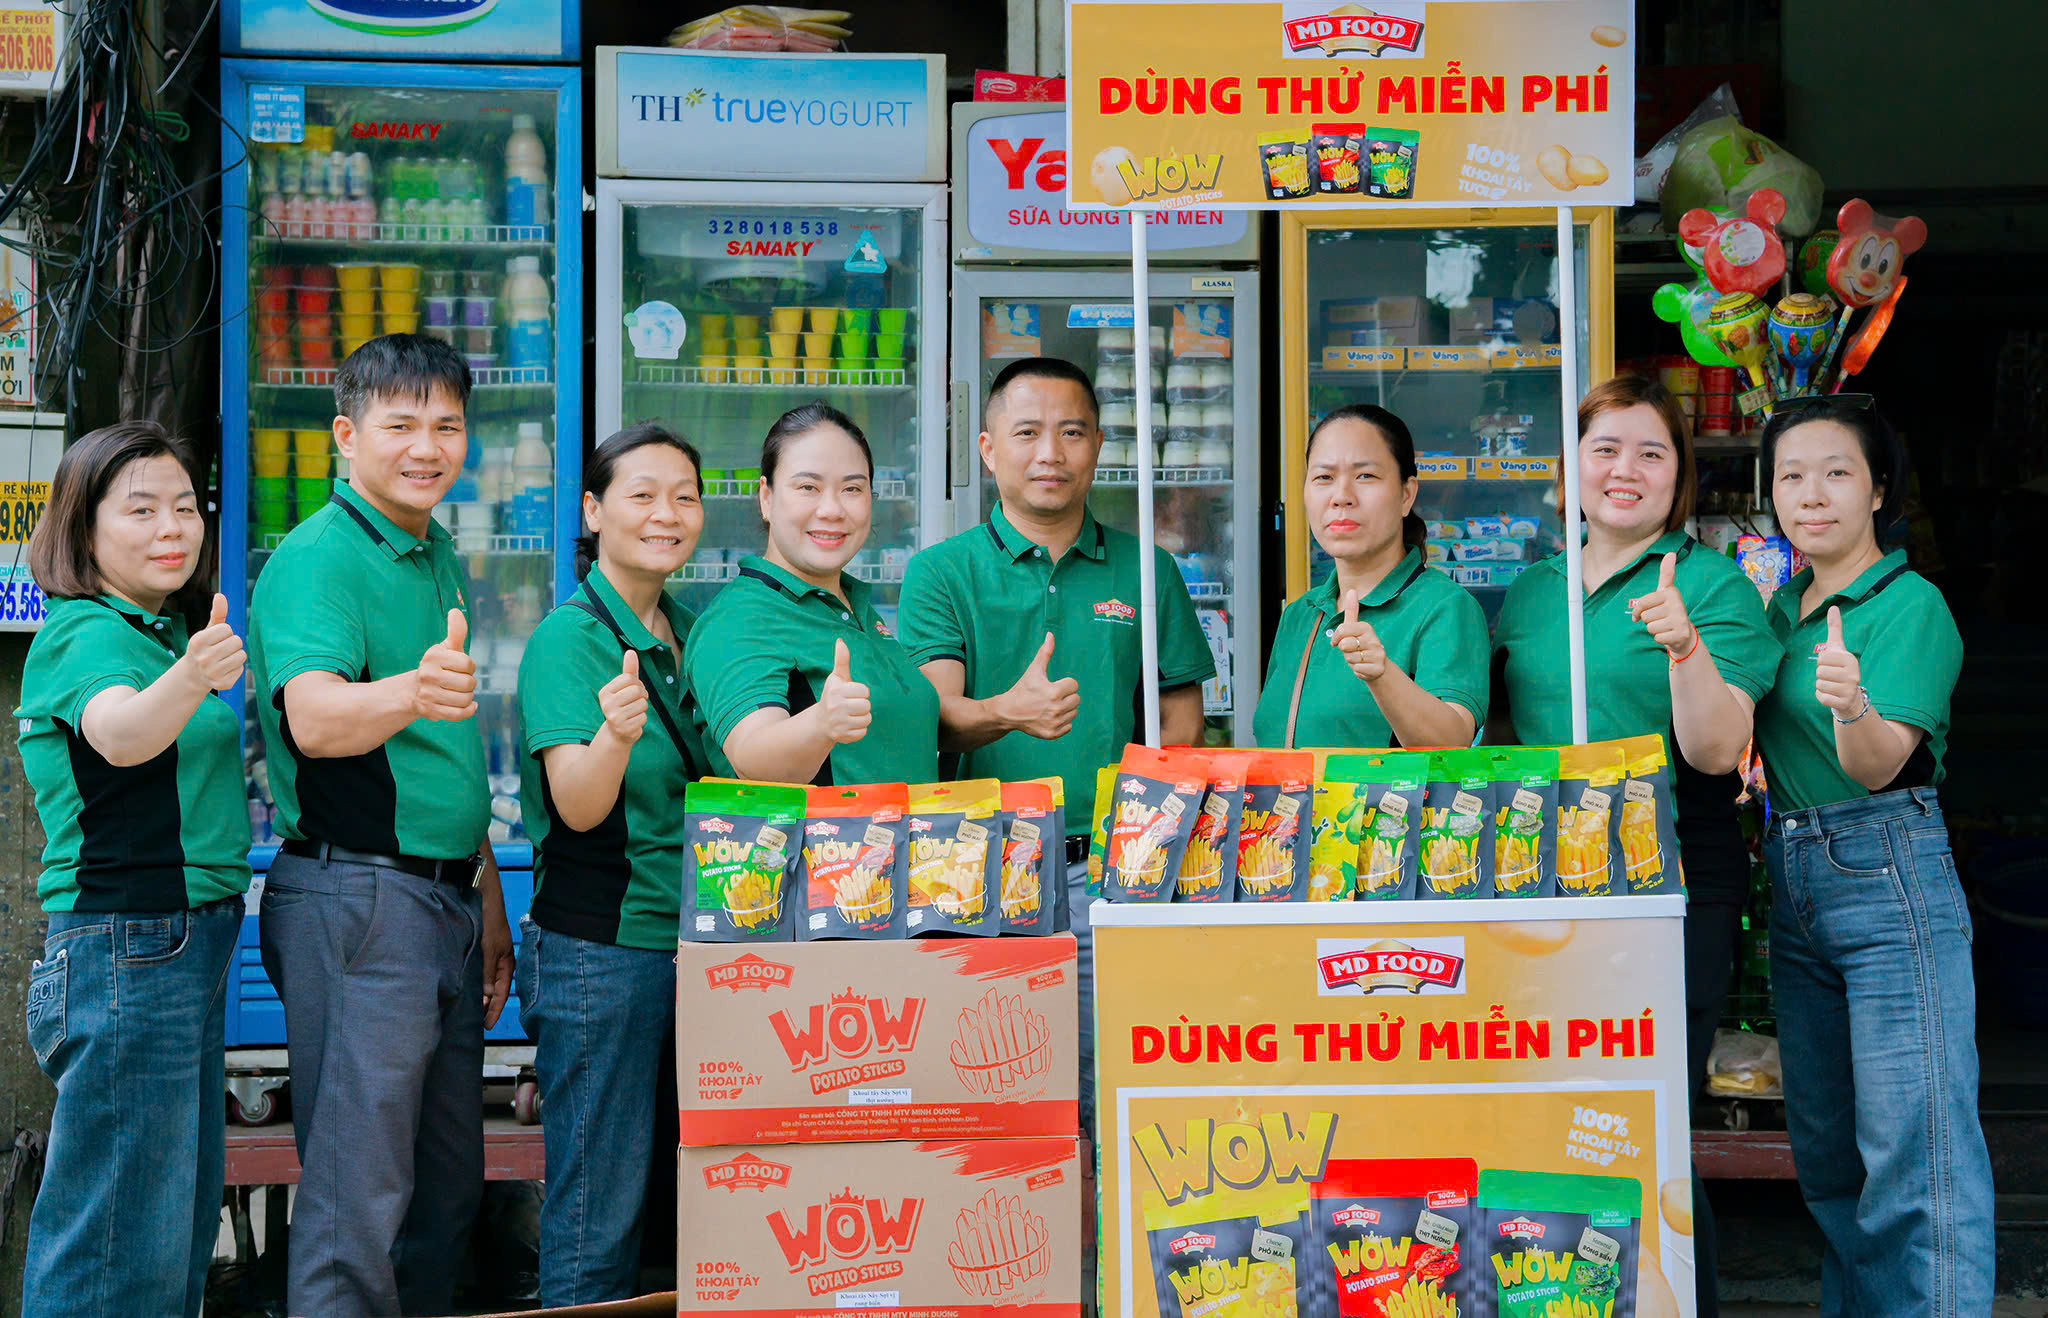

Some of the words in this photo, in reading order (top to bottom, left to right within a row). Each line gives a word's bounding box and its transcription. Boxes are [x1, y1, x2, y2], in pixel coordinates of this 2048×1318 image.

[1296, 20, 1332, 40] MD
[1340, 19, 1406, 39] FOOD
[1100, 66, 1242, 115] DÙNG
[1257, 65, 1366, 115] THỬ
[1377, 60, 1511, 114] MIỄN
[1522, 62, 1608, 113] PHÍ
[632, 95, 682, 122] TH
[351, 122, 443, 145] SANAKY
[1466, 144, 1521, 173] 100%
[1116, 153, 1223, 201] WOW
[1160, 195, 1194, 211] POTATO
[1008, 205, 1052, 225] SỮA
[726, 240, 815, 257] SANAKY
[1, 356, 14, 371] M
[1529, 460, 1547, 471] sữa
[693, 840, 754, 868] WOW
[802, 841, 860, 870] WOW
[713, 966, 738, 983] MD
[741, 965, 785, 982] FOOD
[1330, 958, 1369, 978] MD
[1375, 954, 1445, 976] FOOD
[768, 996, 926, 1073] WOW
[1131, 1013, 1277, 1065] DÙNG
[1294, 1009, 1406, 1063] THỬ
[1419, 1004, 1550, 1061] MIỄN
[1567, 1007, 1655, 1058] PHÍ
[698, 1061, 744, 1074] 100%
[813, 1067, 862, 1092] POTATO
[863, 1060, 904, 1079] STICKS
[698, 1077, 738, 1087] KHOAI
[738, 1073, 764, 1087] TÂY
[698, 1089, 728, 1100] TƯƠI
[836, 1109, 858, 1118] CÔNG
[871, 1109, 892, 1117] TNHH
[1571, 1105, 1629, 1137] 100%
[1568, 1128, 1613, 1152] KHOAI
[1613, 1141, 1640, 1159] TÂY
[1132, 1110, 1339, 1207] WOW
[710, 1167, 735, 1183] MD
[738, 1165, 782, 1181] FOOD
[1336, 1212, 1350, 1221] MD
[1351, 1211, 1376, 1221] FOOD
[766, 1196, 924, 1274] WOW
[1502, 1224, 1516, 1233] MD
[1517, 1223, 1541, 1234] FOOD
[1173, 1240, 1186, 1250] MD
[1187, 1237, 1212, 1247] FOOD
[1582, 1244, 1599, 1256] RONG
[1272, 1249, 1285, 1259] MAI
[1327, 1236, 1412, 1278] WOW
[696, 1261, 741, 1274] 100%
[809, 1269, 860, 1294] POTATO
[860, 1261, 902, 1281] STICKS
[1490, 1251, 1574, 1288] WOW
[696, 1277, 735, 1287] KHOAI
[736, 1274, 761, 1287] TÂY
[1168, 1257, 1248, 1305] WOW
[1346, 1278, 1375, 1294] POTATO
[1375, 1272, 1400, 1284] STICKS
[696, 1290, 725, 1301] TƯƠI
[1507, 1290, 1536, 1304] POTATO
[1536, 1286, 1559, 1297] STICKS
[857, 1310, 867, 1318] TY
[869, 1310, 890, 1318] TNHH
[891, 1310, 908, 1318] MTV
[909, 1309, 930, 1317] MINH
[1191, 1301, 1219, 1318] POTATO
